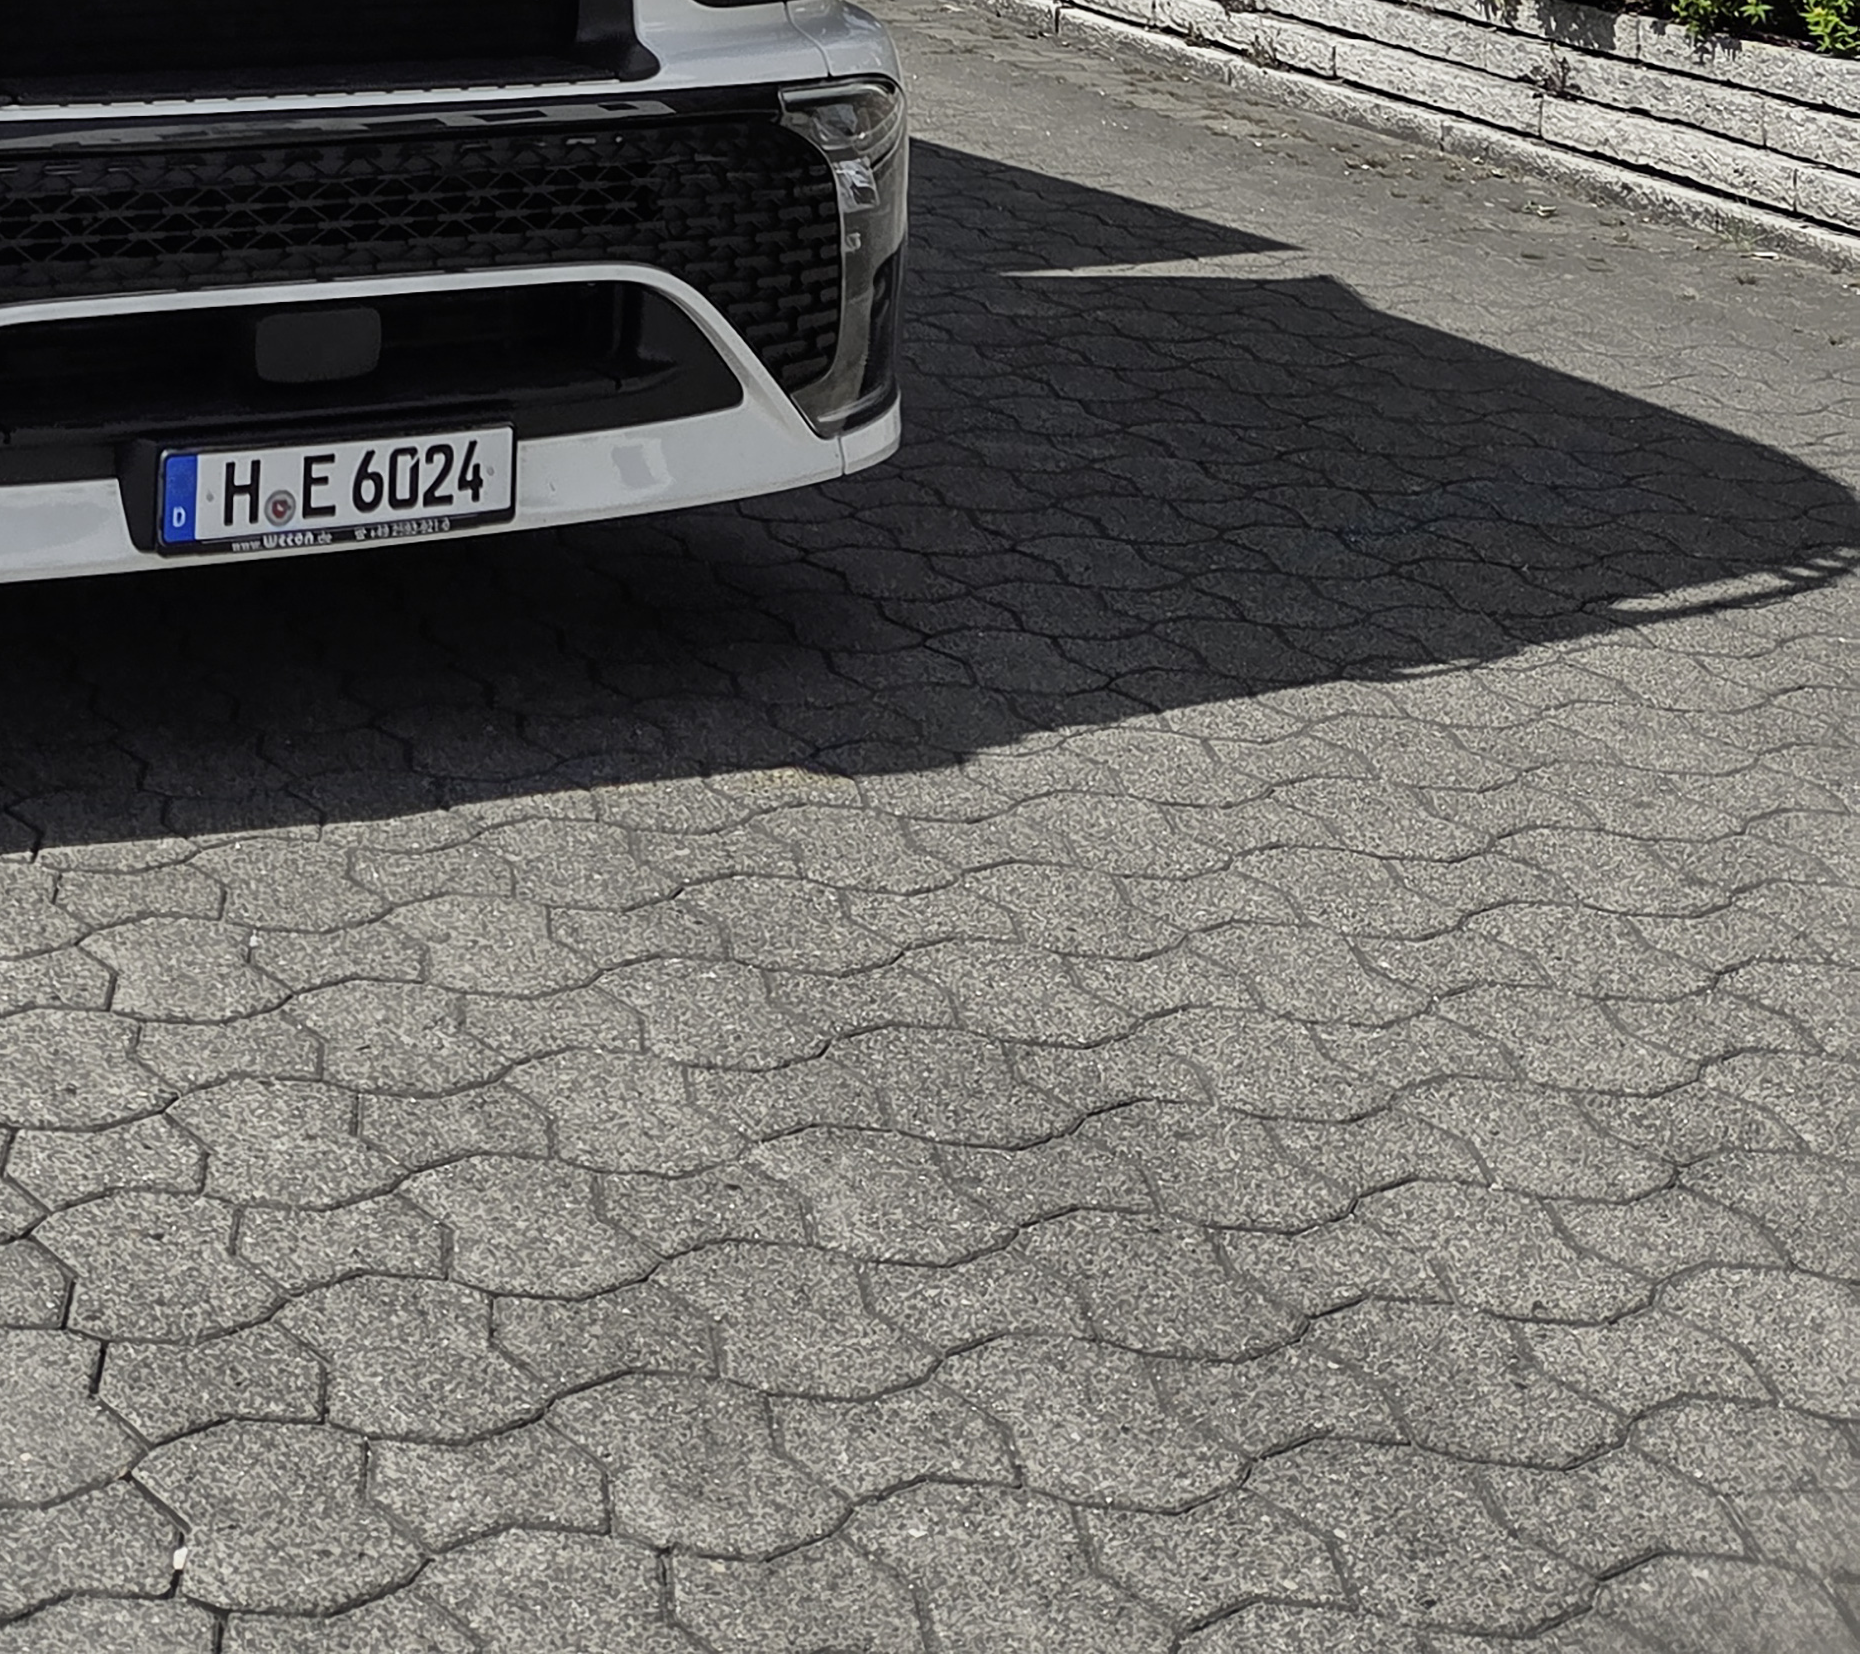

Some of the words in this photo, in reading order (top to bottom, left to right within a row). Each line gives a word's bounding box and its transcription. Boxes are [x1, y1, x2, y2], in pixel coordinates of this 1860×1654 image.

[223, 458, 262, 527] H
[301, 452, 337, 520] E
[351, 439, 484, 514] 6024
[172, 506, 186, 528] D
